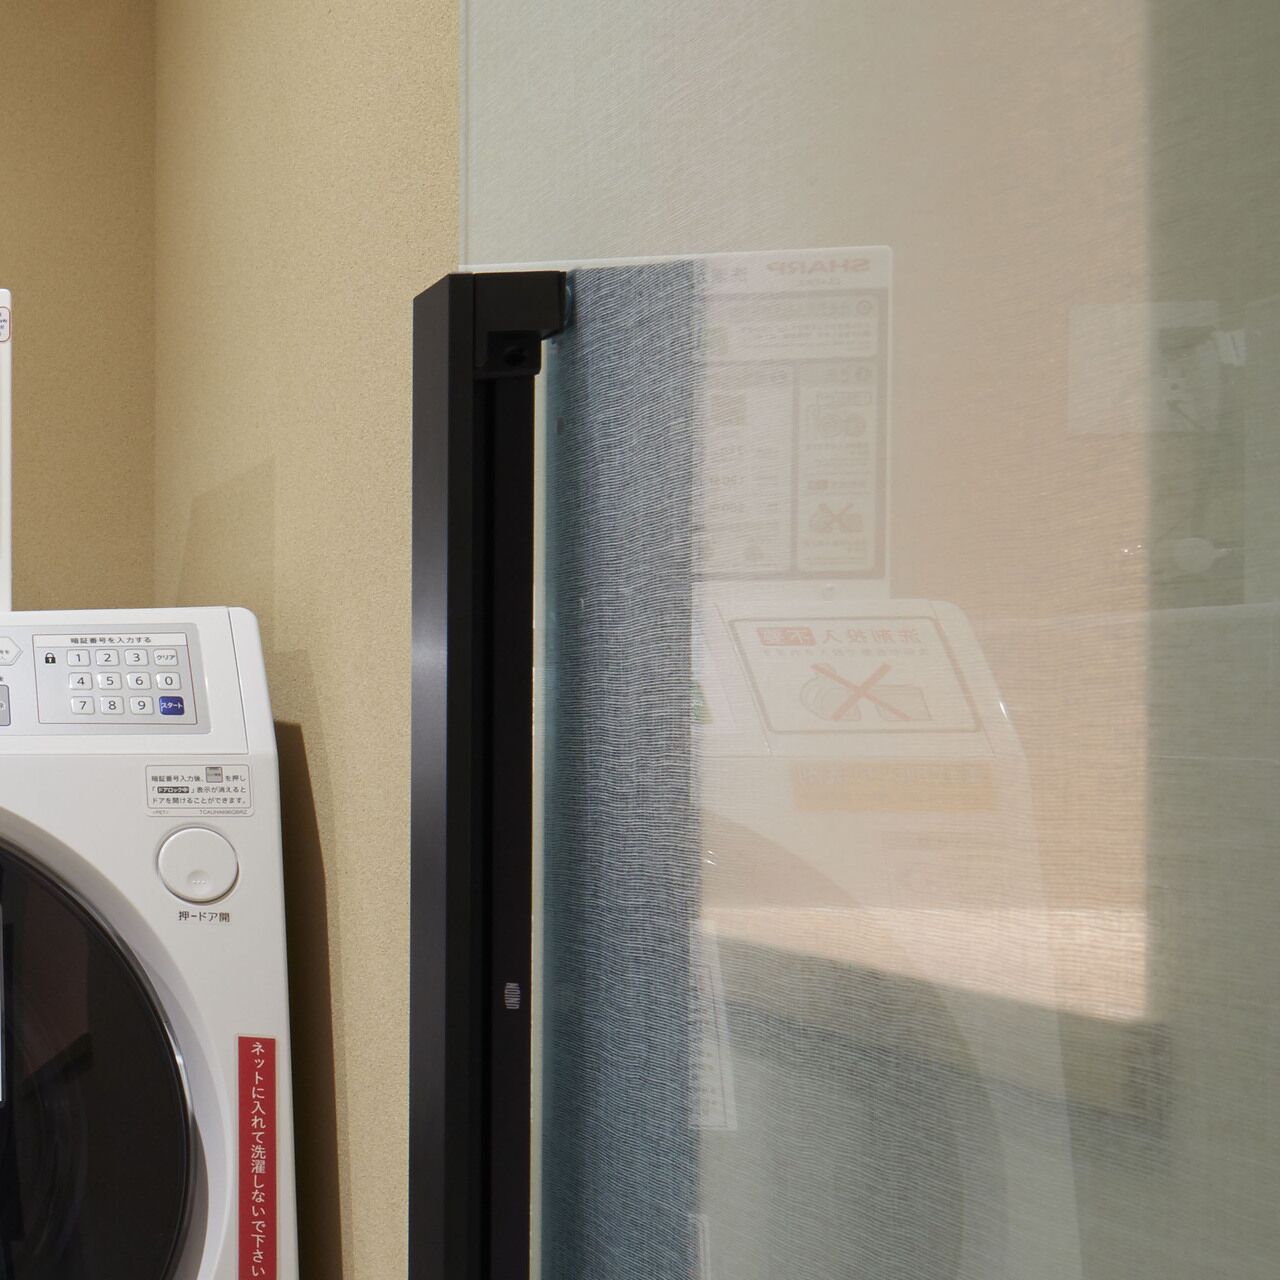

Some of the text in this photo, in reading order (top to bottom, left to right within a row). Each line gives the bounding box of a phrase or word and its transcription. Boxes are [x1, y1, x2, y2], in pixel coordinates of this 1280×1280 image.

[70, 636, 151, 644] 暗証番号を入力する
[103, 654, 111, 662] 2
[133, 653, 141, 662] 3
[76, 677, 85, 685] 4
[106, 677, 114, 685] 5
[135, 676, 143, 685] 6
[79, 701, 145, 710] 7 8 9
[160, 702, 183, 710] スタート
[251, 1041, 266, 1277] ネットに入れて洗濯しないで下さい
